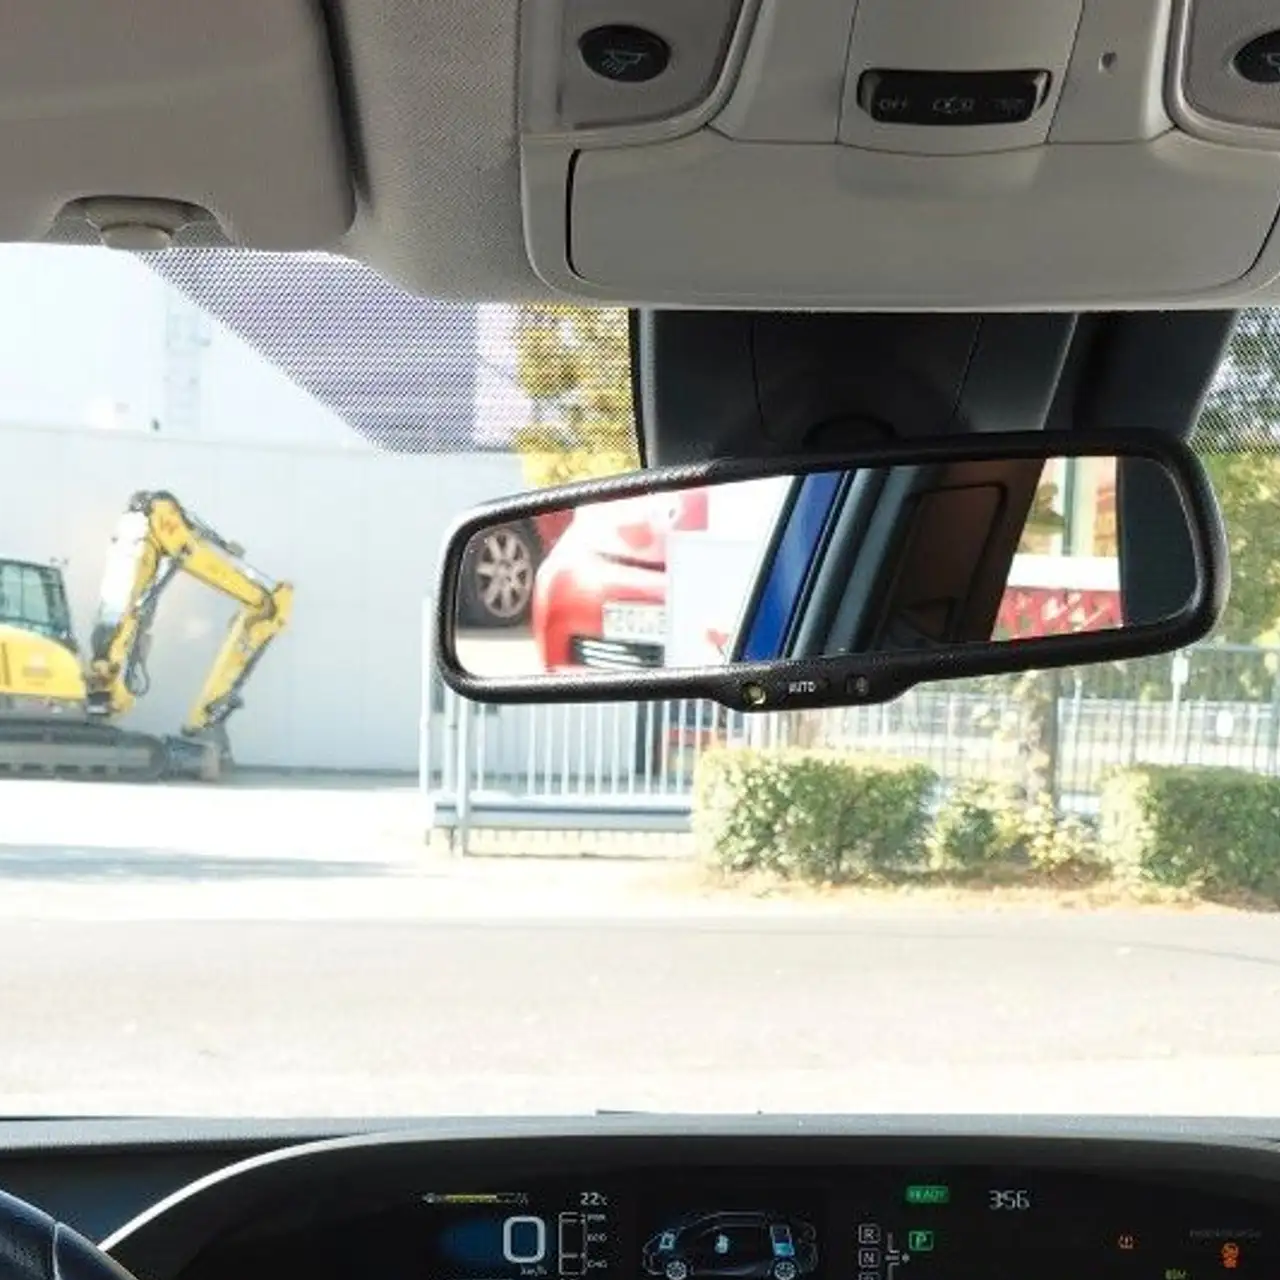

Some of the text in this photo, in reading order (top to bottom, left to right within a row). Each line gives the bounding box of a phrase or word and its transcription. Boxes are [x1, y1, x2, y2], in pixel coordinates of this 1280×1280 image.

[988, 1190, 1030, 1210] 356
[503, 1216, 546, 1263] 0
[915, 1231, 928, 1249] P
